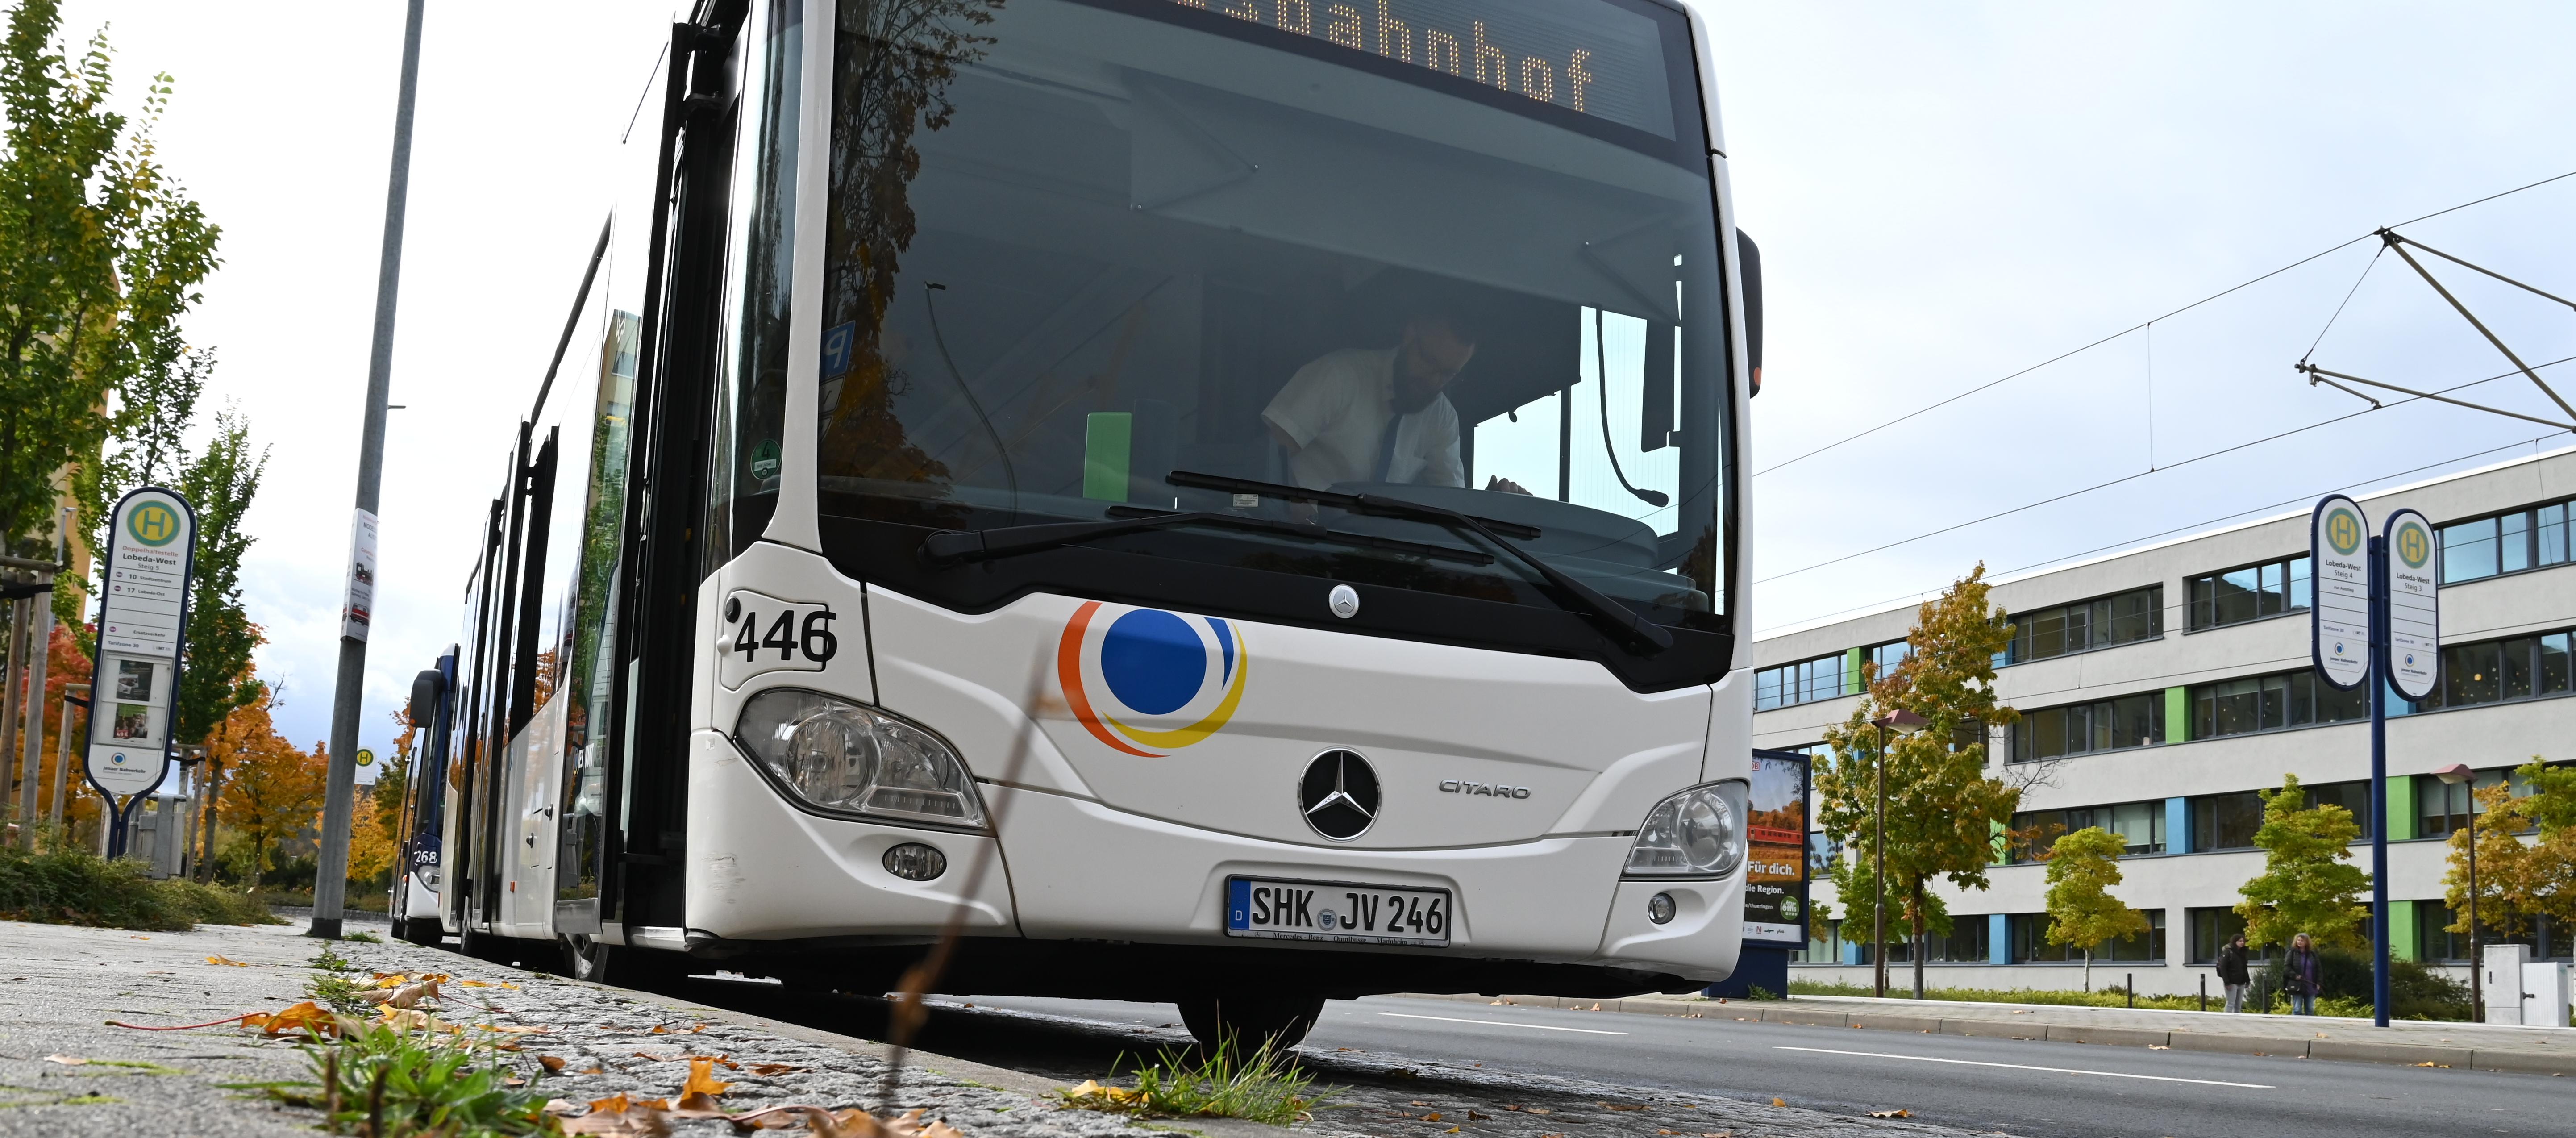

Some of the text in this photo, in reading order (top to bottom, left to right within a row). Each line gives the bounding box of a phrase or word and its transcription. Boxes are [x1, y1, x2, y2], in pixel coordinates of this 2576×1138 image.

[142, 510, 166, 537] H
[2336, 517, 2351, 546] H
[2406, 531, 2420, 559] H
[122, 546, 178, 557] Doppelhaltestelle
[123, 553, 176, 565] Lobeda-West
[2326, 559, 2361, 571] Lobeda-West
[2334, 570, 2348, 579] Steig
[2397, 572, 2430, 584] Lobeda-West
[2405, 583, 2417, 592] Steig
[734, 610, 837, 662] 446
[360, 752, 368, 763] H
[1439, 779, 1532, 799] CITARO
[416, 850, 437, 864] 268
[1748, 861, 1795, 876] Für dich.
[1757, 885, 1785, 895] Region.
[1235, 910, 1243, 921] D
[1252, 887, 1443, 934] SHK JV 246
[1273, 932, 1303, 940] Mercedes
[1333, 935, 1366, 943] Omnibusse
